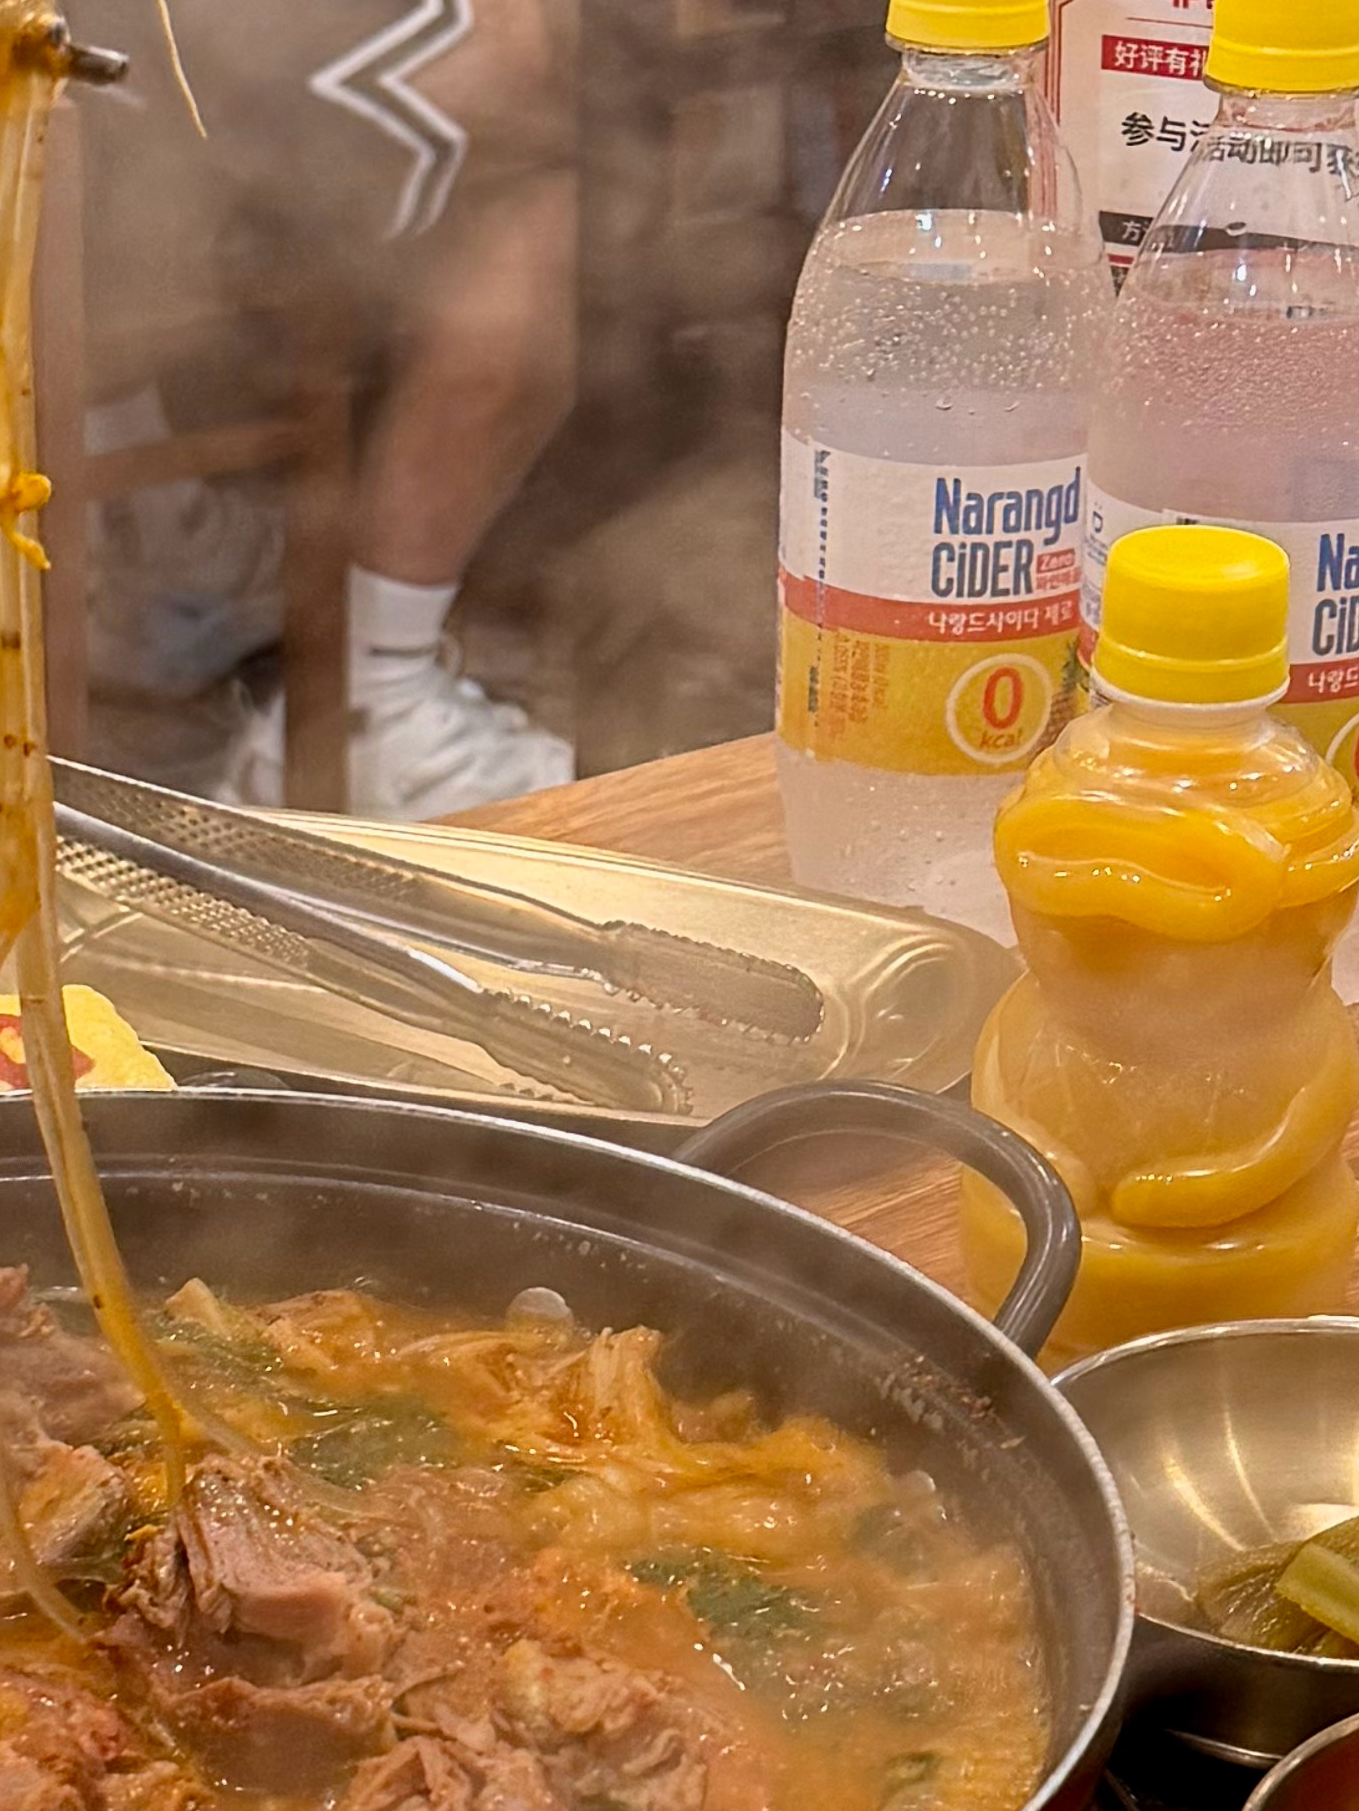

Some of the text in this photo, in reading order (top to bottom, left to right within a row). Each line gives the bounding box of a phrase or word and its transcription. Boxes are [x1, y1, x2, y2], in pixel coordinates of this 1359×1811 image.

[933, 466, 1081, 546] Narangd
[928, 599, 1074, 636] 나랑드사이다 제로
[981, 666, 1025, 731] 0
[979, 728, 1024, 750] kcal
